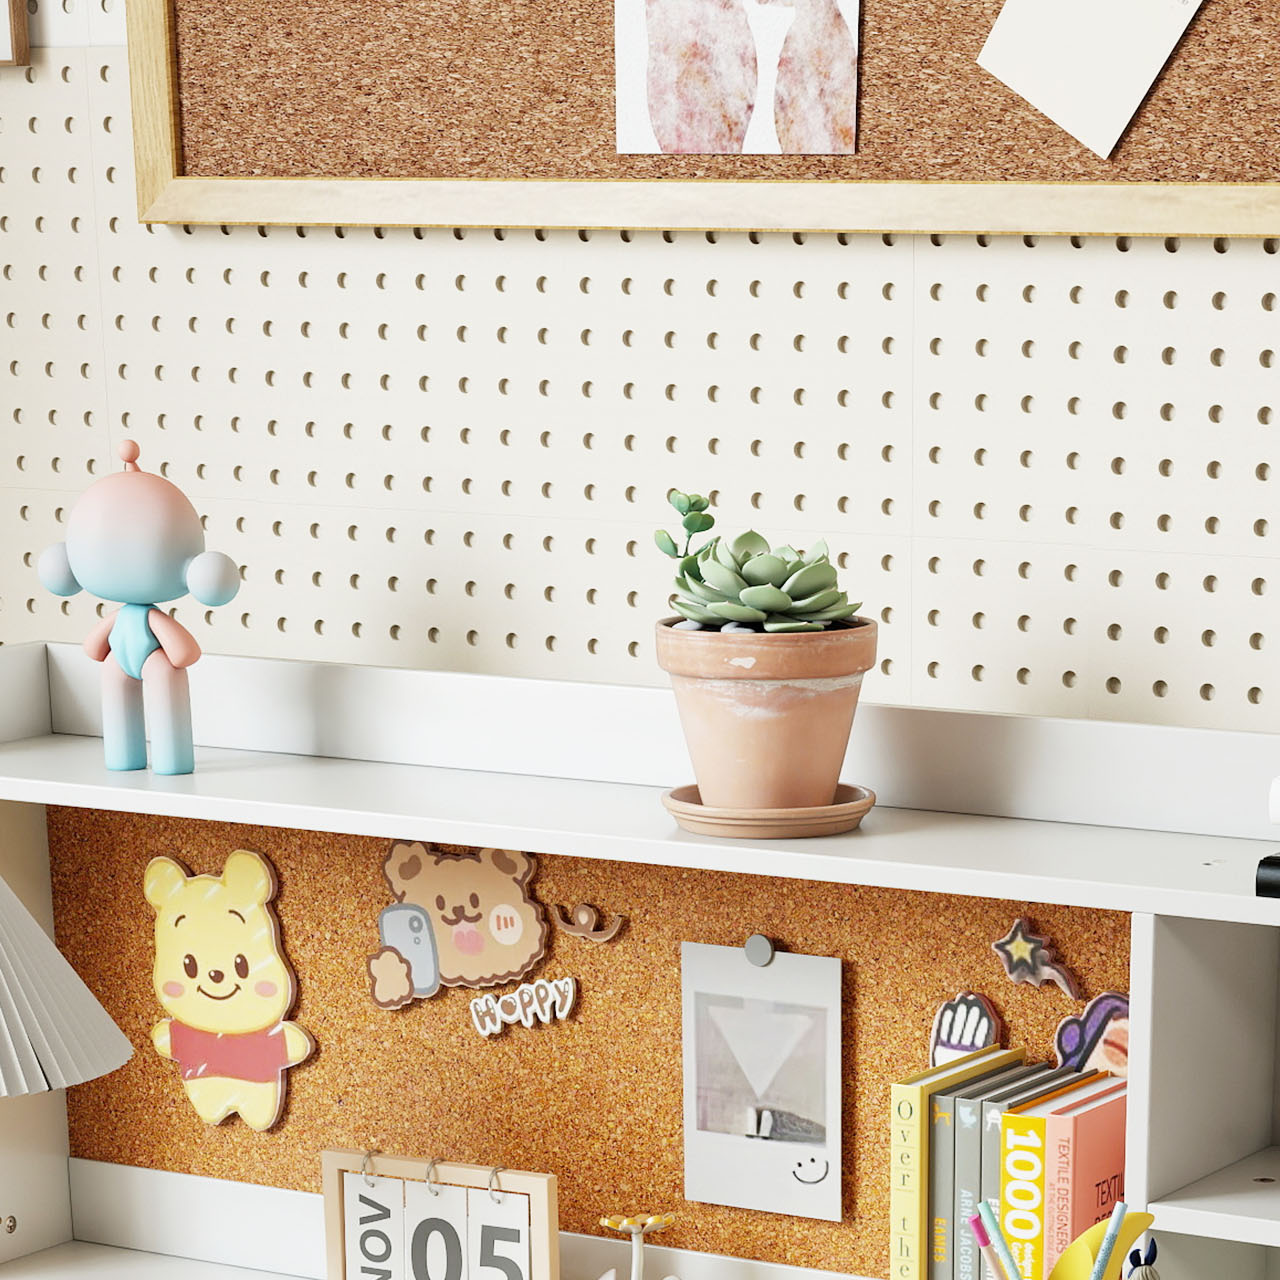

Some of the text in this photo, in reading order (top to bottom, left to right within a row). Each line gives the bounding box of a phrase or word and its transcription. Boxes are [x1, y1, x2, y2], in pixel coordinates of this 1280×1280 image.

[897, 1099, 914, 1187] Over
[1004, 1128, 1043, 1240] 1000
[1056, 1136, 1071, 1255] TEXTILE DESIGNERS
[1095, 1172, 1124, 1208] TEXTIL
[899, 1215, 911, 1279] the
